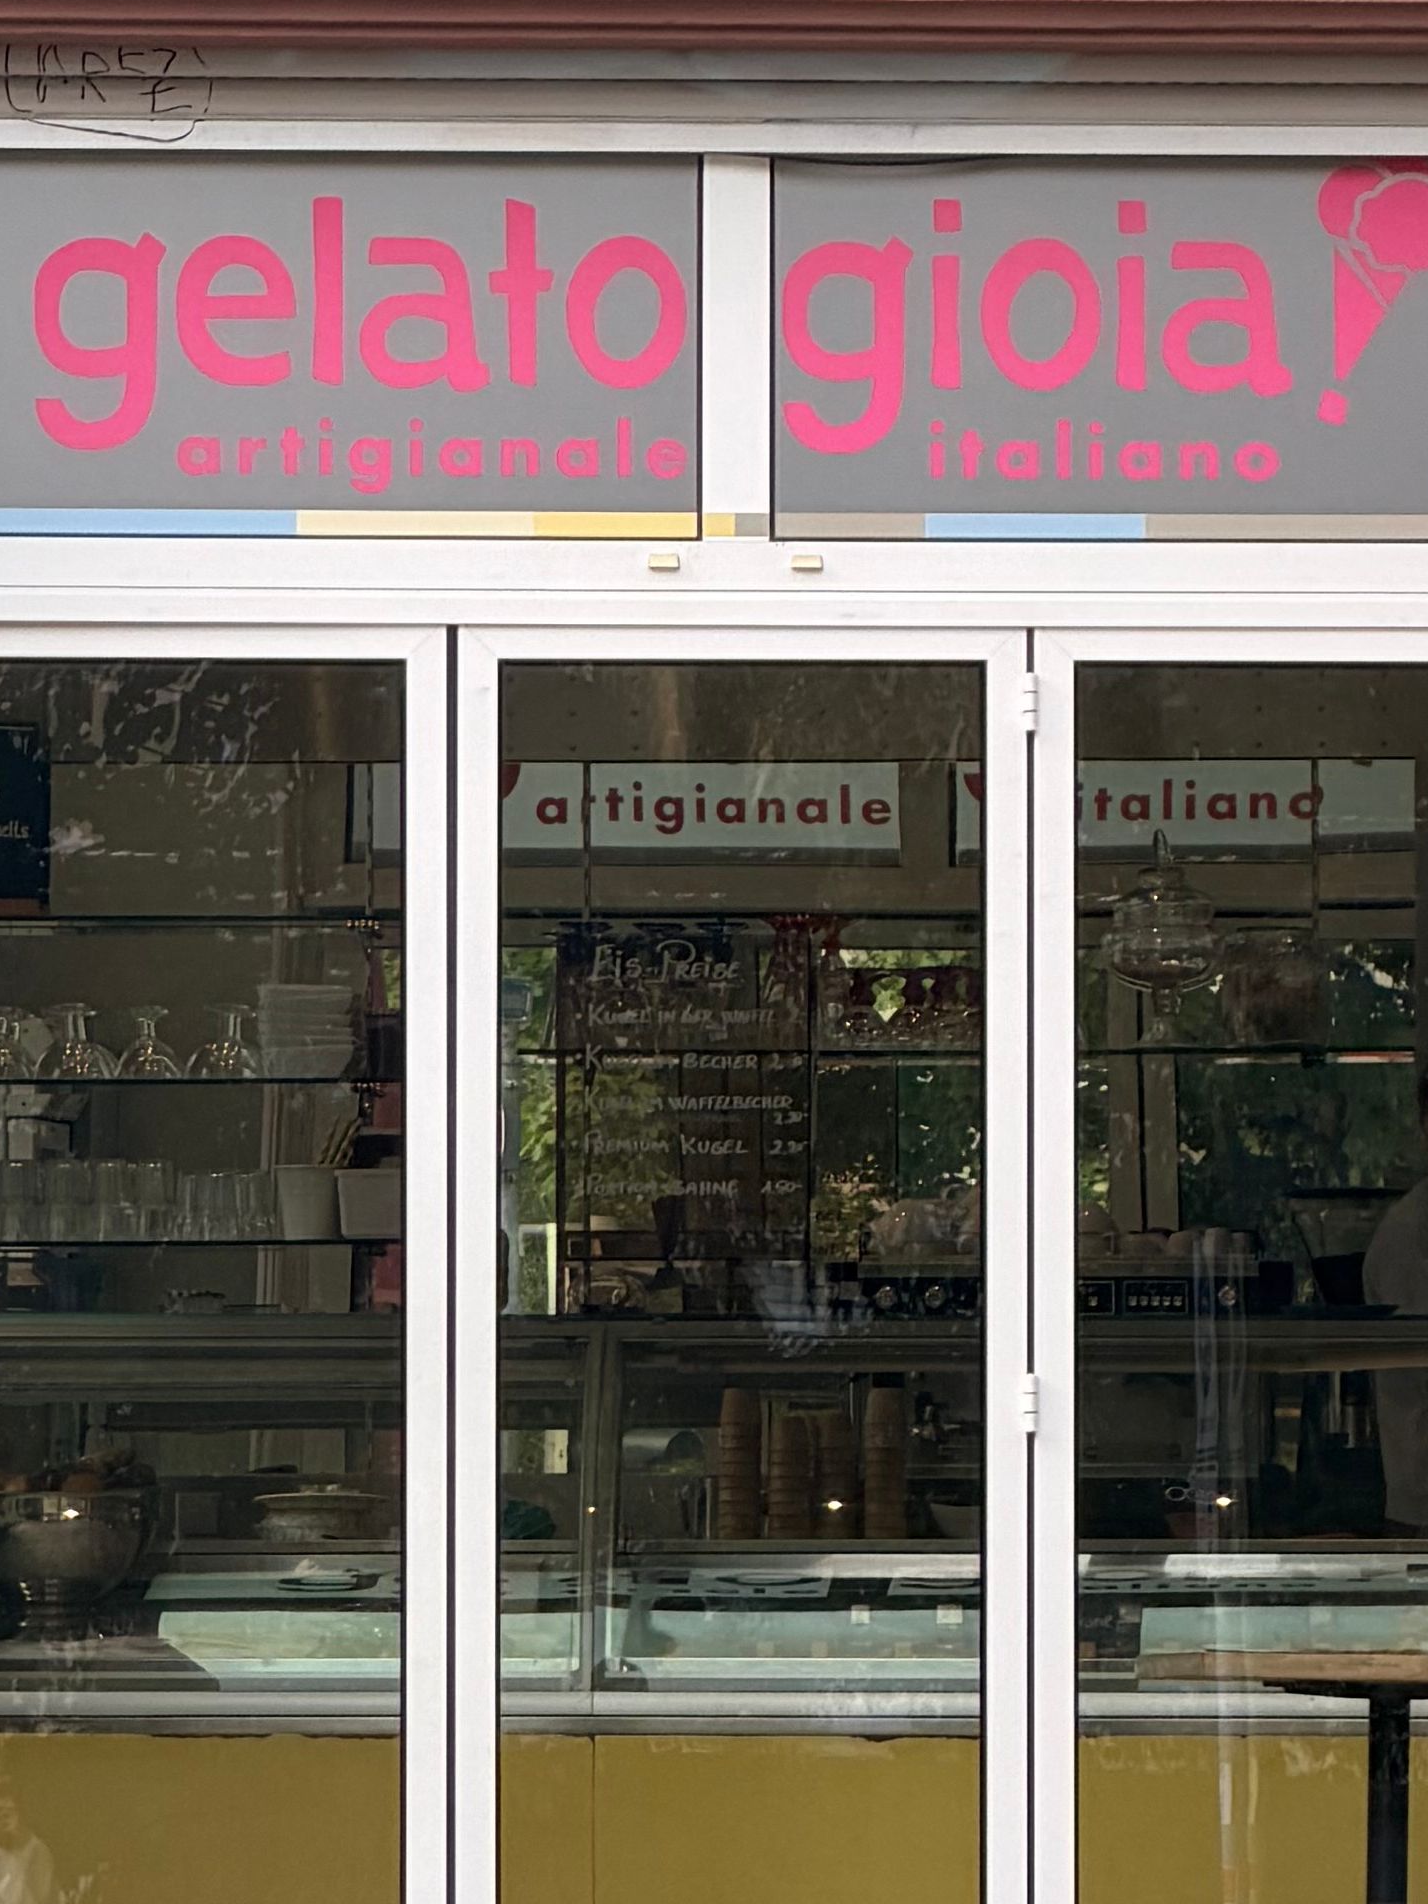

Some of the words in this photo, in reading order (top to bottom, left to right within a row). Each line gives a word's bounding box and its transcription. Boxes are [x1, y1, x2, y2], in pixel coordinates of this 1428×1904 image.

[34, 197, 687, 451] gelato
[176, 416, 689, 494] artigianale
[928, 418, 1282, 484] italiano
[680, 1134, 748, 1156] KUGEL
